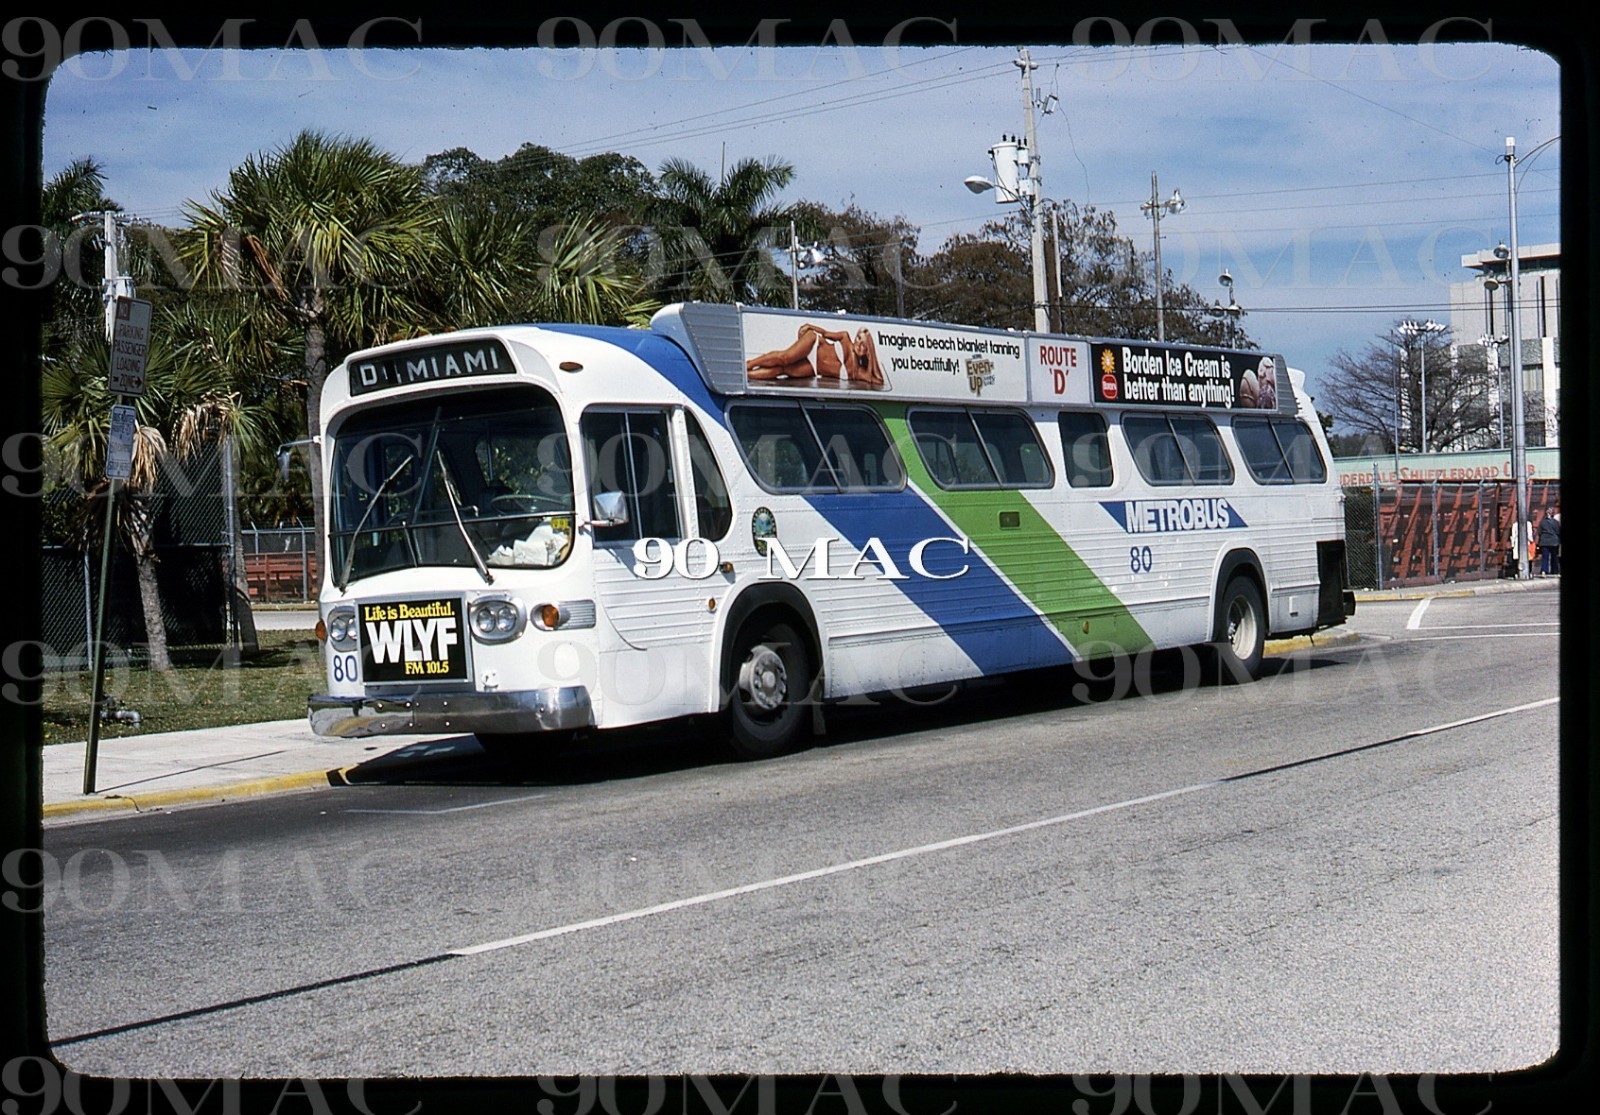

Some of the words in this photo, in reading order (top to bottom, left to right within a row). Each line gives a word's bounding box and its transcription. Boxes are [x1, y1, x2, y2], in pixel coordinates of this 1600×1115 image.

[120, 323, 144, 340] PARKING
[114, 339, 146, 357] PASSENGER
[878, 331, 917, 351] Imagine
[918, 336, 924, 347] a
[926, 335, 956, 350] beach
[957, 337, 989, 353] blanket
[989, 340, 1020, 359] tanning
[1040, 345, 1077, 367] ROUTE
[116, 356, 141, 372] LOADING
[360, 364, 378, 386] D
[406, 347, 499, 381] MIAMI
[891, 357, 909, 372] you
[910, 355, 960, 375] beautifully!
[1122, 347, 1163, 376] Borden
[1165, 350, 1182, 377] Ice
[1184, 352, 1219, 378] Cream
[1221, 356, 1231, 378] is
[1124, 376, 1160, 400] better
[1161, 379, 1187, 402] than
[1188, 379, 1235, 409] anything!
[1400, 466, 1500, 480] SHUFFLEBOARD
[1503, 461, 1535, 477] CB
[1125, 498, 1230, 532] METROBUS
[1130, 546, 1152, 573] 80
[364, 605, 386, 621] Life
[387, 604, 398, 620] is
[399, 601, 455, 619] Beautiful.
[365, 617, 458, 664] WLYF
[333, 655, 358, 682] 80
[405, 661, 424, 675] FM
[426, 661, 450, 674] 101.5
